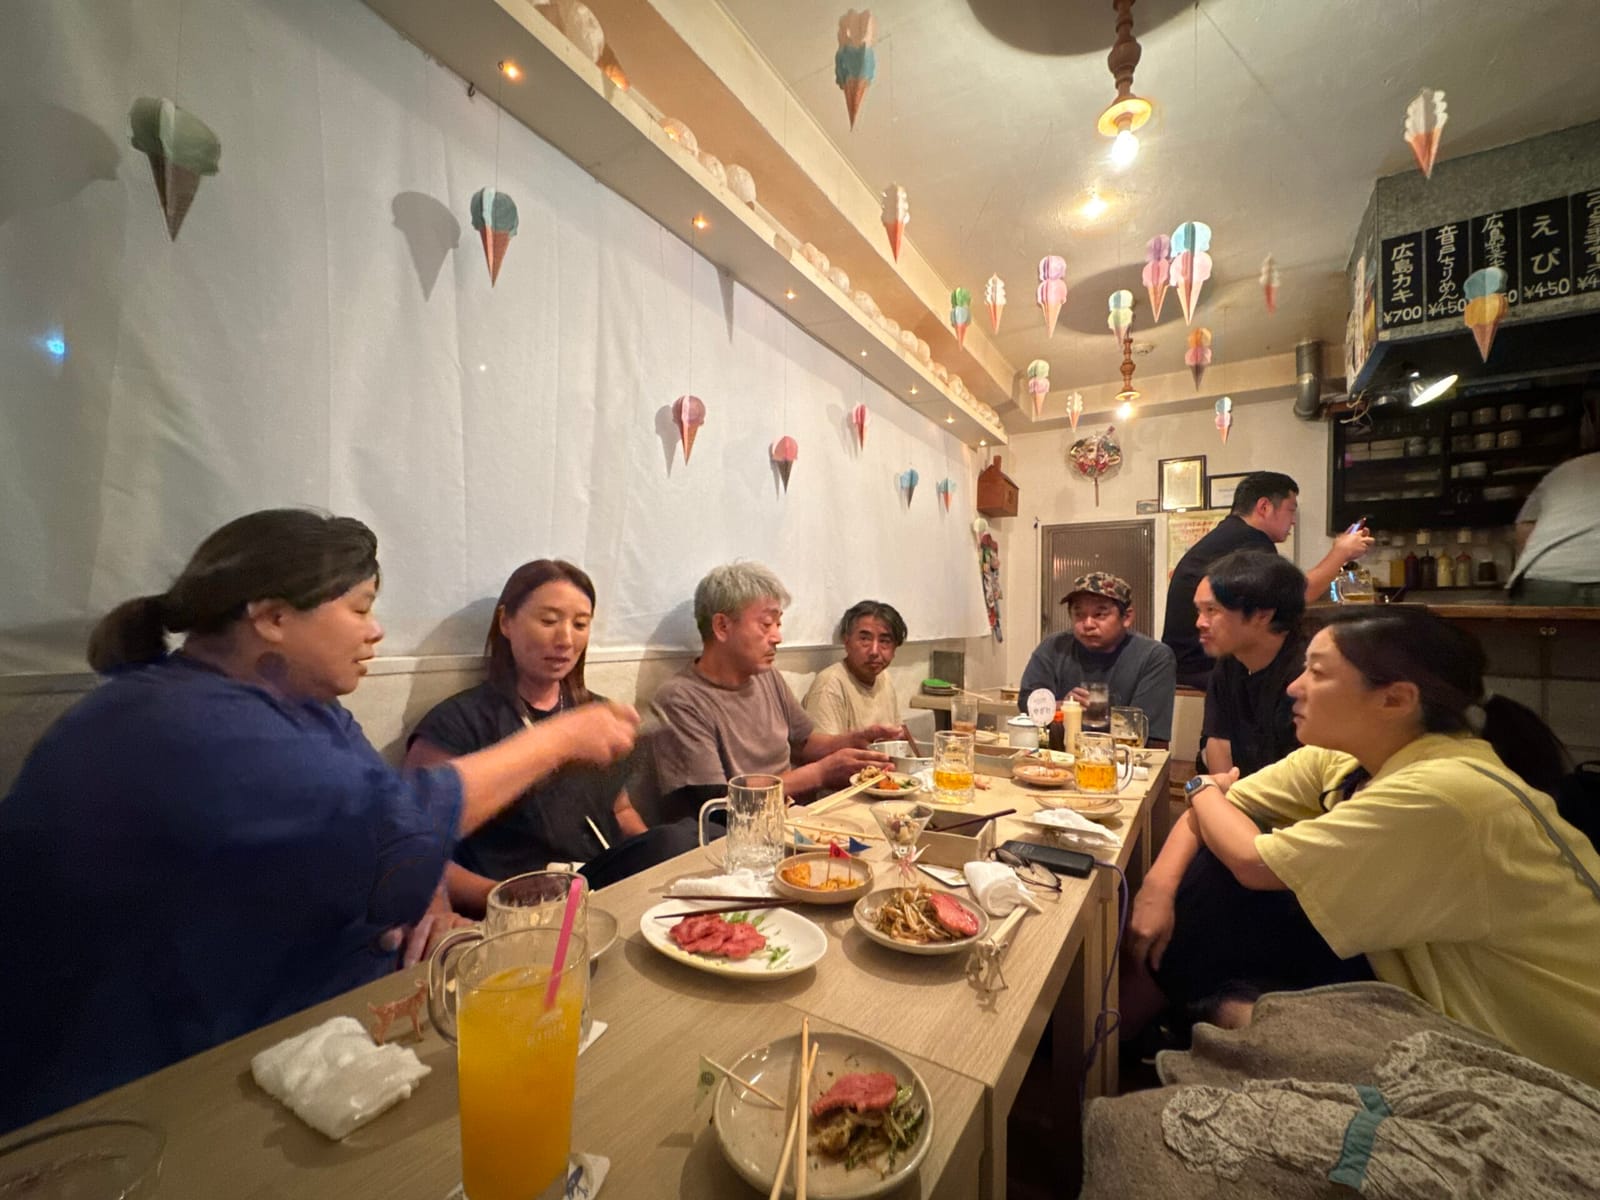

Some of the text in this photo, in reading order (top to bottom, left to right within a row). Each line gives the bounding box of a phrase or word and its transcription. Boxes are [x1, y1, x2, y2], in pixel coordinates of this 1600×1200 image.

[1435, 225, 1459, 302] 音戸ちりめん
[1531, 215, 1560, 275] えび
[1390, 242, 1415, 303] 広島カキ
[1524, 278, 1570, 298] ¥450
[1383, 305, 1422, 324] ¥700
[1428, 298, 1466, 317] ¥450
